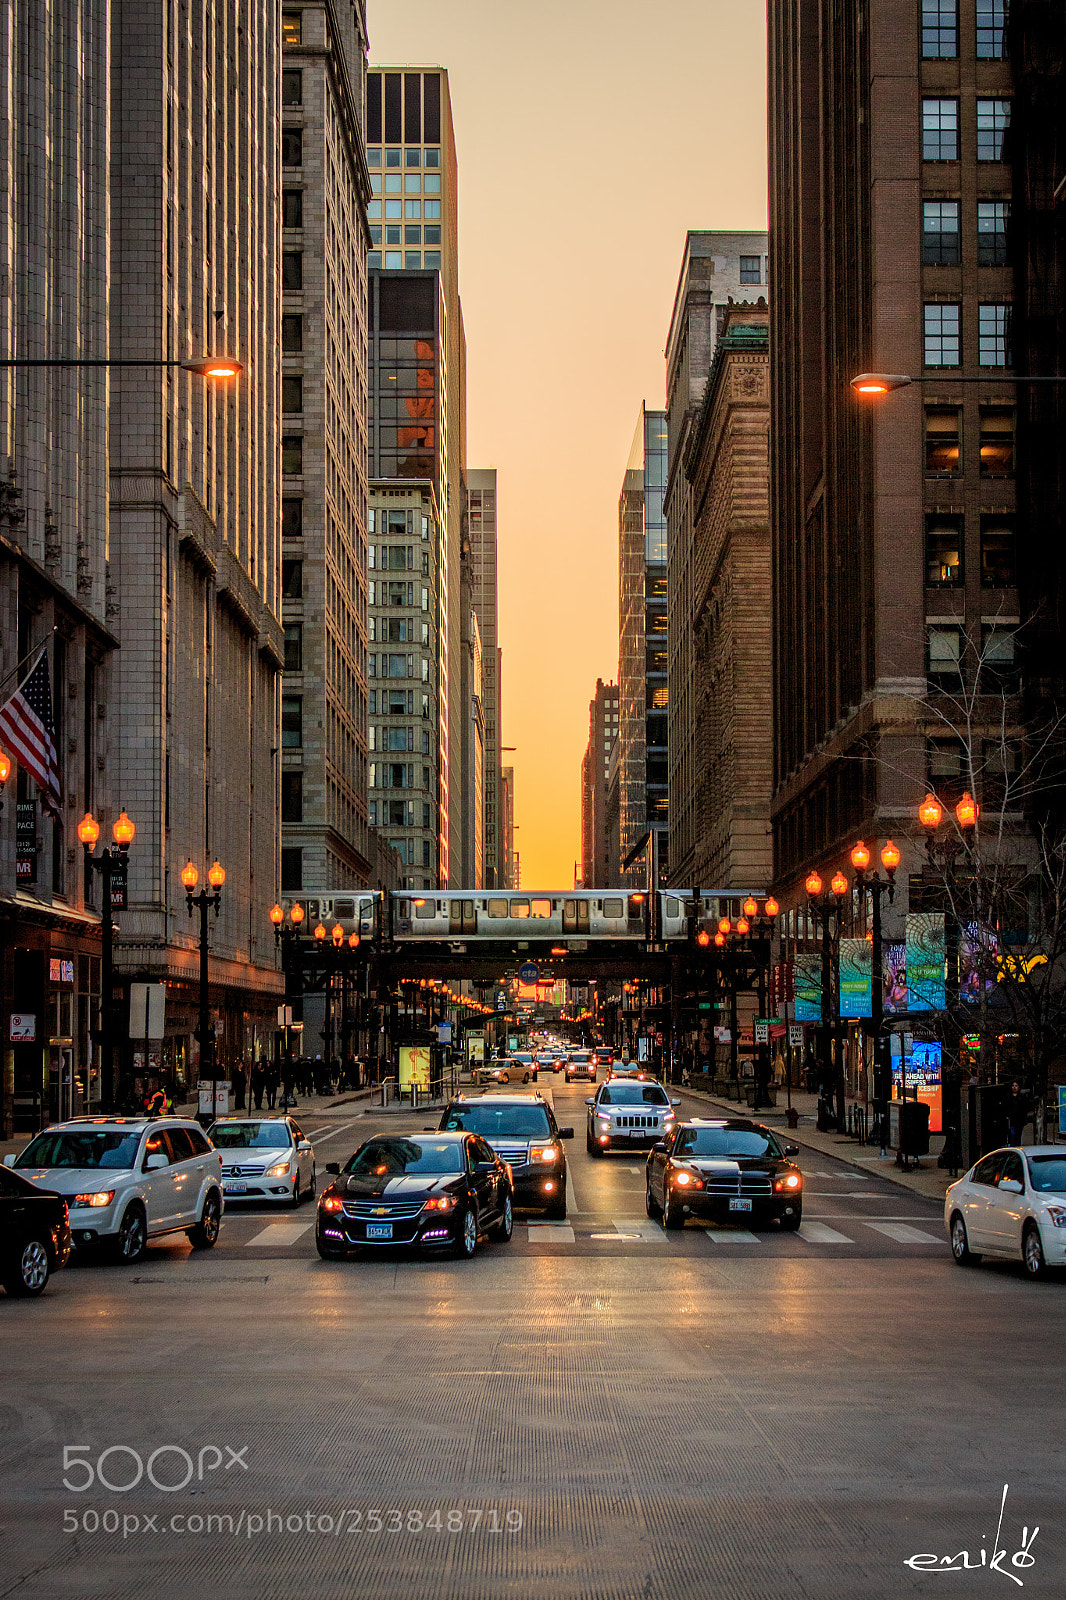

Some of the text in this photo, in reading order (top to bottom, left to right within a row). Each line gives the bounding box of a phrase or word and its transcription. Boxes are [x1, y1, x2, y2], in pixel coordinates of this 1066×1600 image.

[16, 804, 34, 812] RIME
[16, 821, 35, 829] PACE
[521, 969, 537, 977] cta
